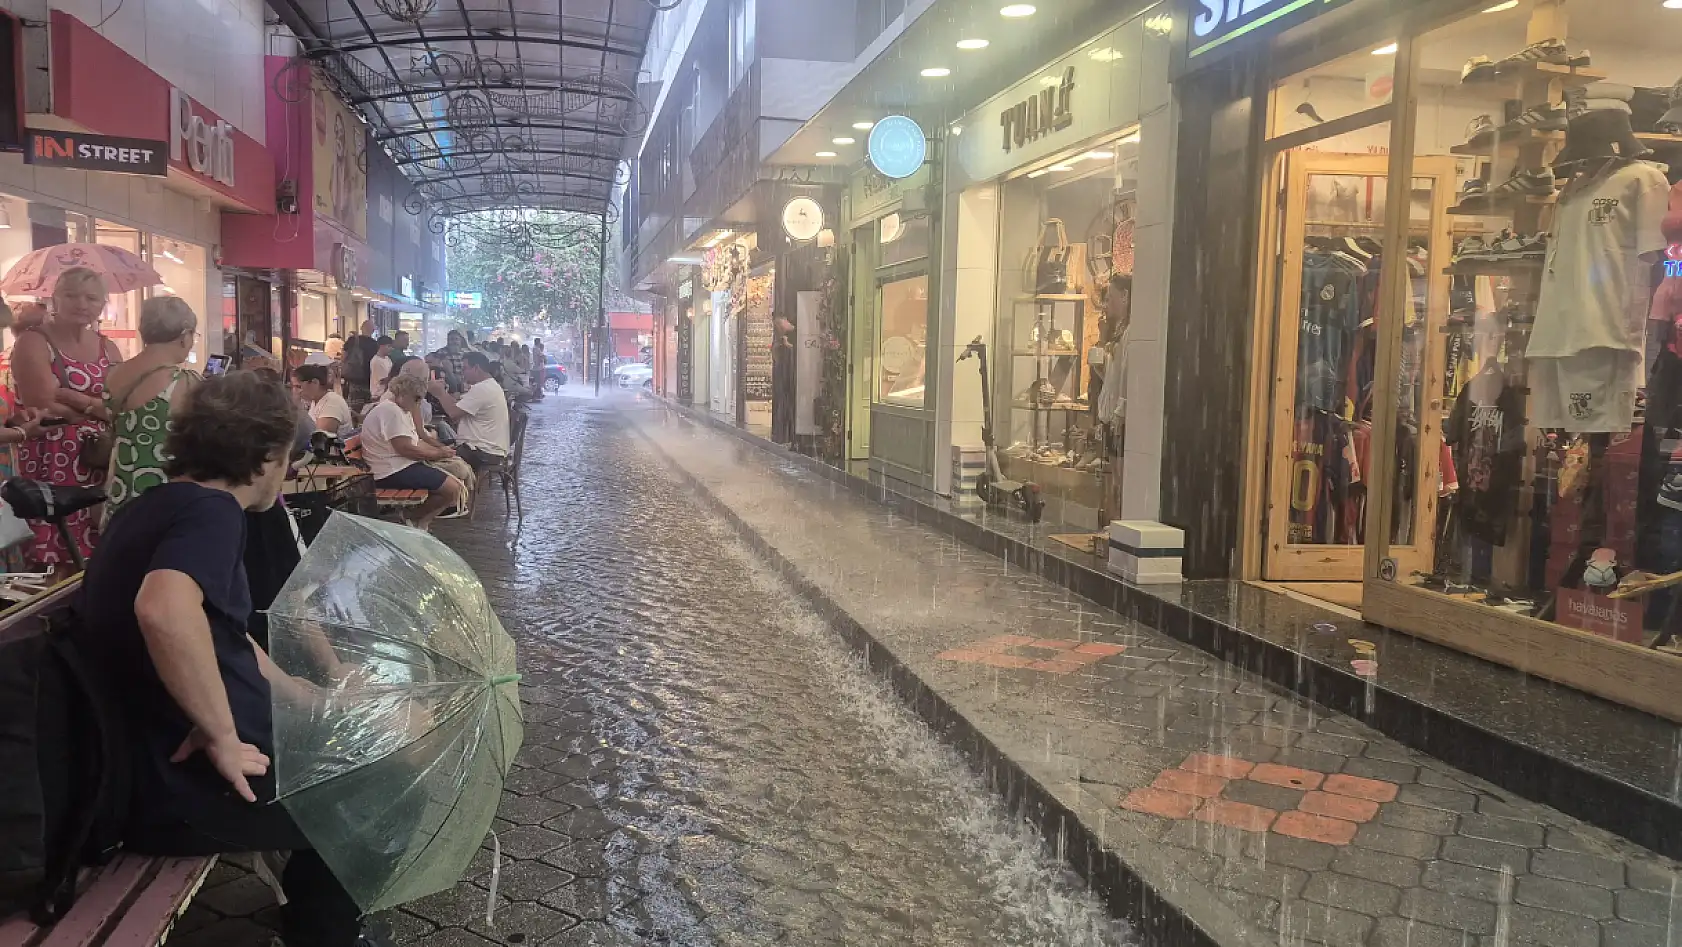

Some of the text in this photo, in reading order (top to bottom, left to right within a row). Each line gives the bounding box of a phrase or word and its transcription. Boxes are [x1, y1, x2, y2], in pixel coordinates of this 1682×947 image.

[34, 135, 154, 164] IN STREET
[169, 86, 234, 187] Penti
[1569, 597, 1628, 623] havaianas
